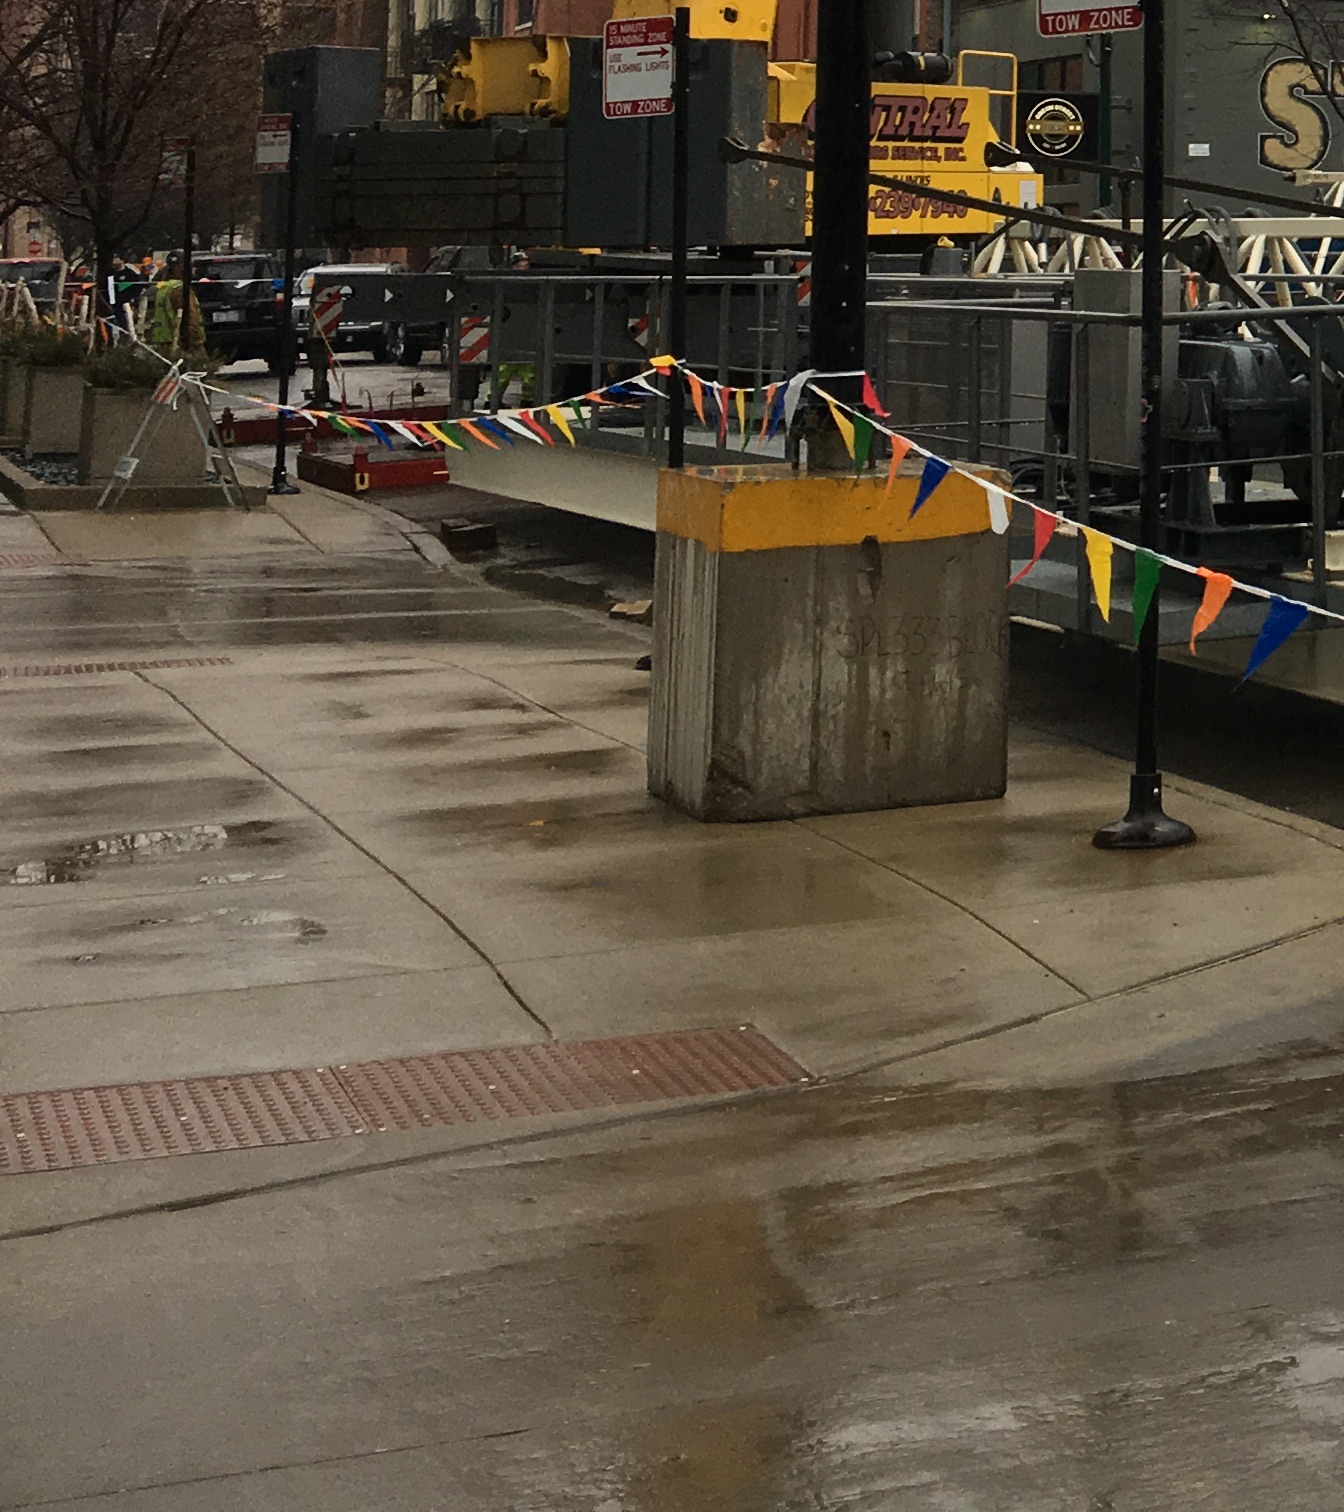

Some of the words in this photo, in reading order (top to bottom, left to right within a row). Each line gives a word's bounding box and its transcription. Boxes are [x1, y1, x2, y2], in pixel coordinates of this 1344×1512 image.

[1046, 13, 1080, 32] TOW
[1089, 9, 1134, 29] ZONE
[609, 25, 618, 35] 15
[620, 23, 647, 34] MINUTE
[609, 34, 644, 45] STANDING
[648, 32, 667, 42] ZONE
[609, 63, 642, 74] FLASHING
[645, 61, 669, 71] LIGHTS
[609, 102, 632, 115] TOW
[637, 100, 667, 113] ZONE
